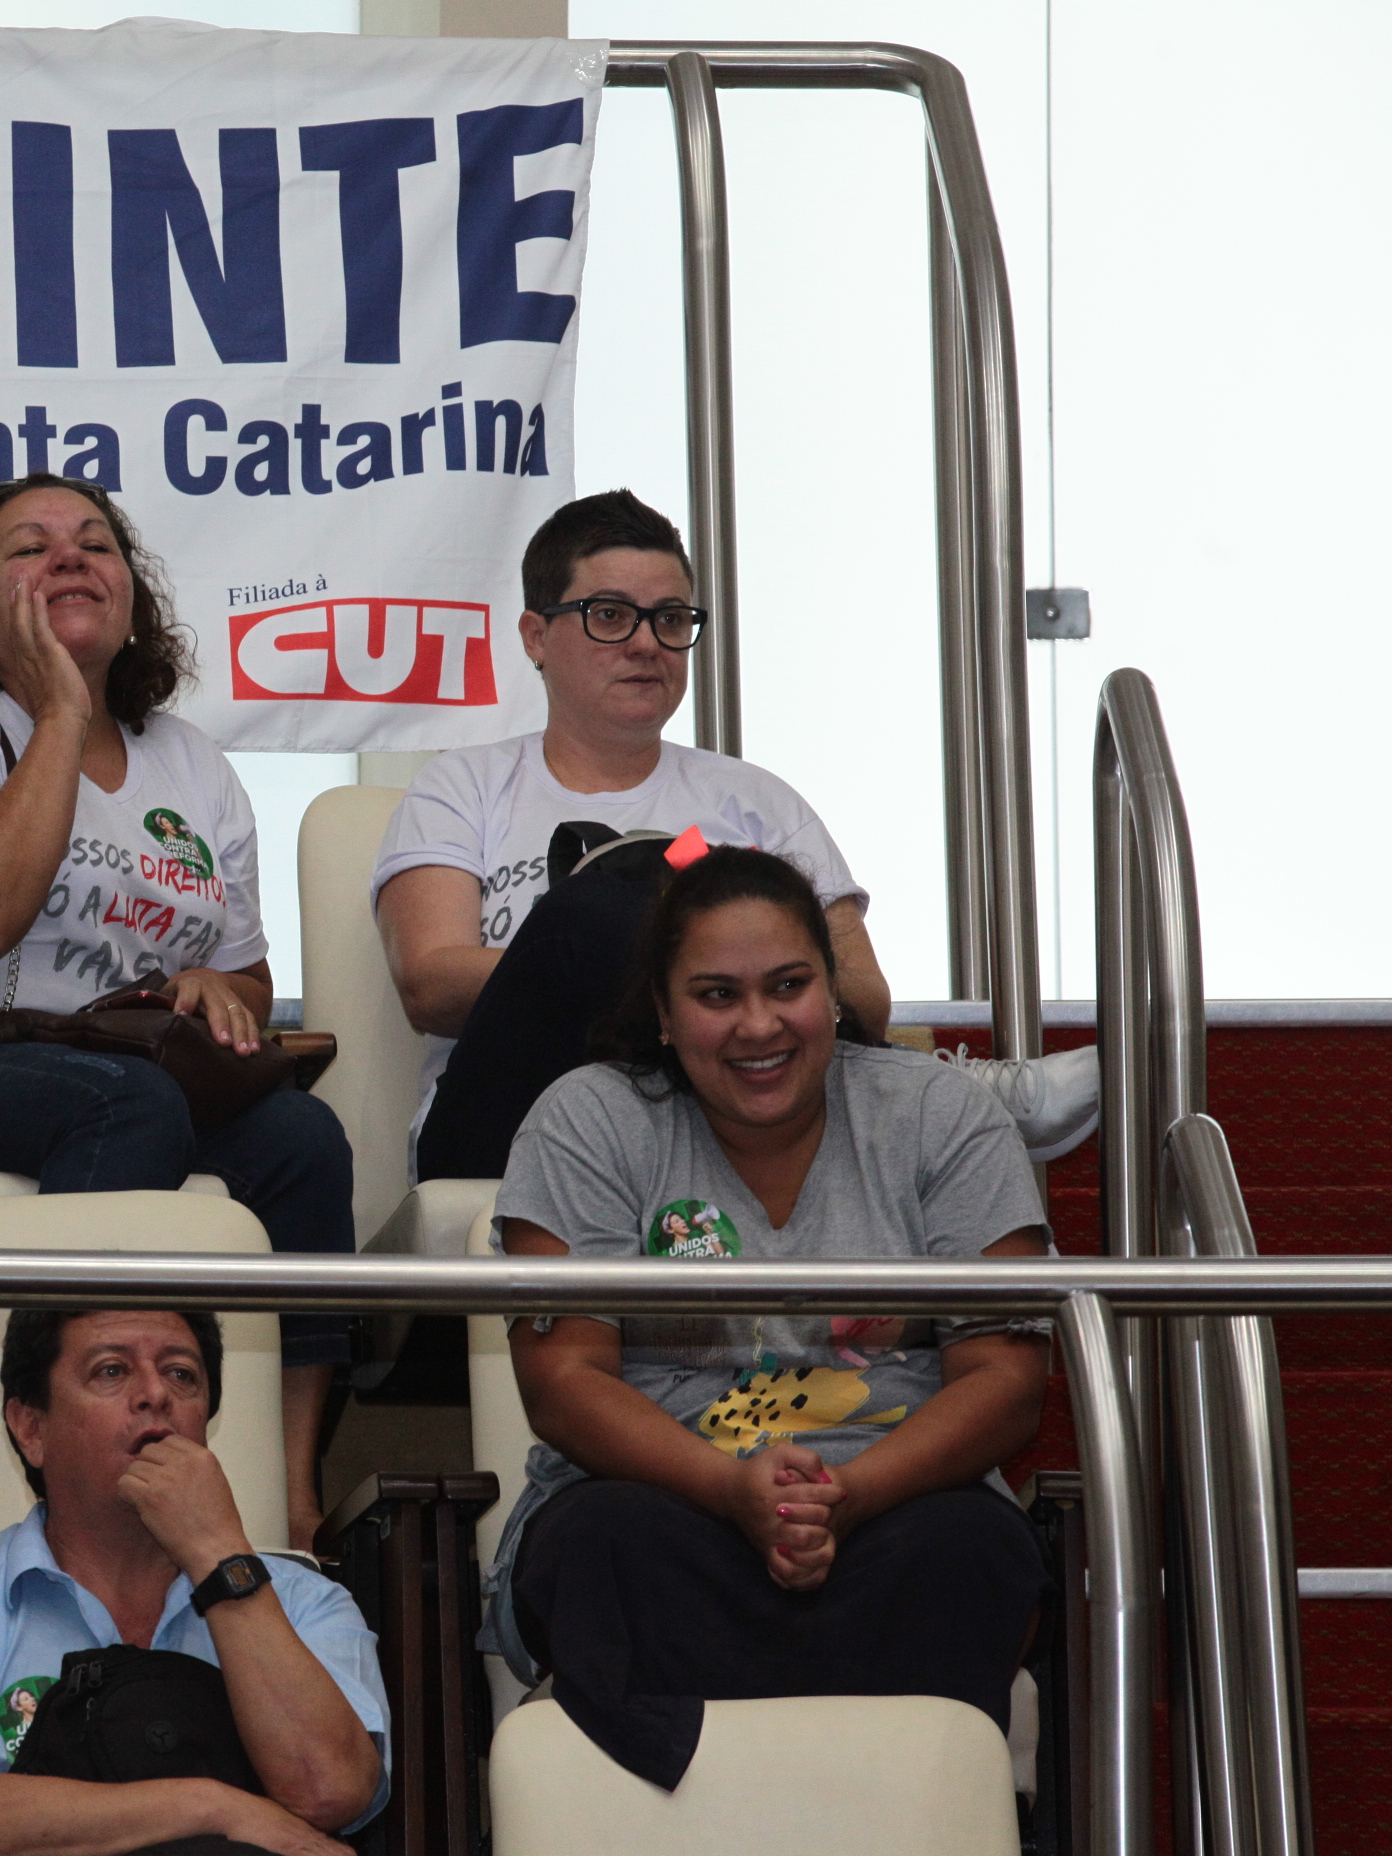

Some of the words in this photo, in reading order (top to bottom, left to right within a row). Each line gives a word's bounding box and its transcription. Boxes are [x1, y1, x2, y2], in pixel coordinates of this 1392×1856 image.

[164, 381, 550, 497] Catarina
[226, 578, 309, 607] Filiada
[314, 573, 329, 591] à
[237, 603, 486, 701] CUT
[65, 837, 135, 875] SSOS
[43, 871, 70, 918] Ó
[78, 885, 102, 929] A
[102, 890, 176, 942] LUTA
[669, 1233, 720, 1257] UNIDOS
